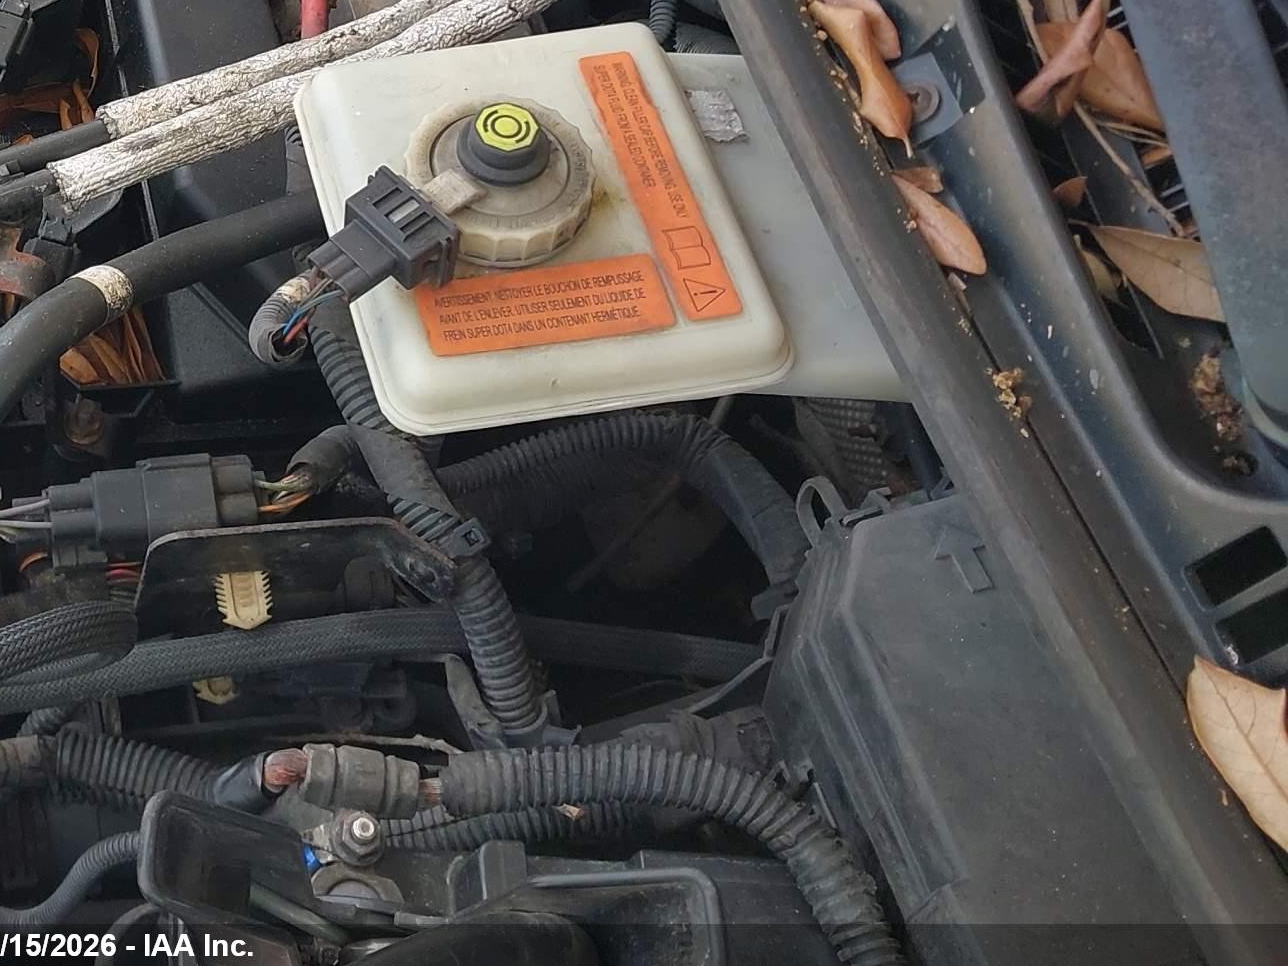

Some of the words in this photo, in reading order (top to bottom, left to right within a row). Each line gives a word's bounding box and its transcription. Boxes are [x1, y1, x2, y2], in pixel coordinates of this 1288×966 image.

[533, 283, 545, 295] LE
[544, 279, 581, 295] BOUCHON
[581, 277, 592, 290] DE
[592, 270, 644, 288] REMPLISSAGE
[463, 310, 474, 322] DE
[515, 300, 548, 315] UTILISER
[548, 295, 592, 312] SEULEMENT
[592, 293, 605, 306] DU
[605, 289, 633, 304] LIQUIDE
[634, 287, 646, 299] DE
[443, 329, 467, 341] FREIN
[466, 325, 492, 339] SUPER
[513, 320, 534, 334] DANS
[534, 318, 547, 331] UN
[546, 312, 591, 329] CONTENANT
